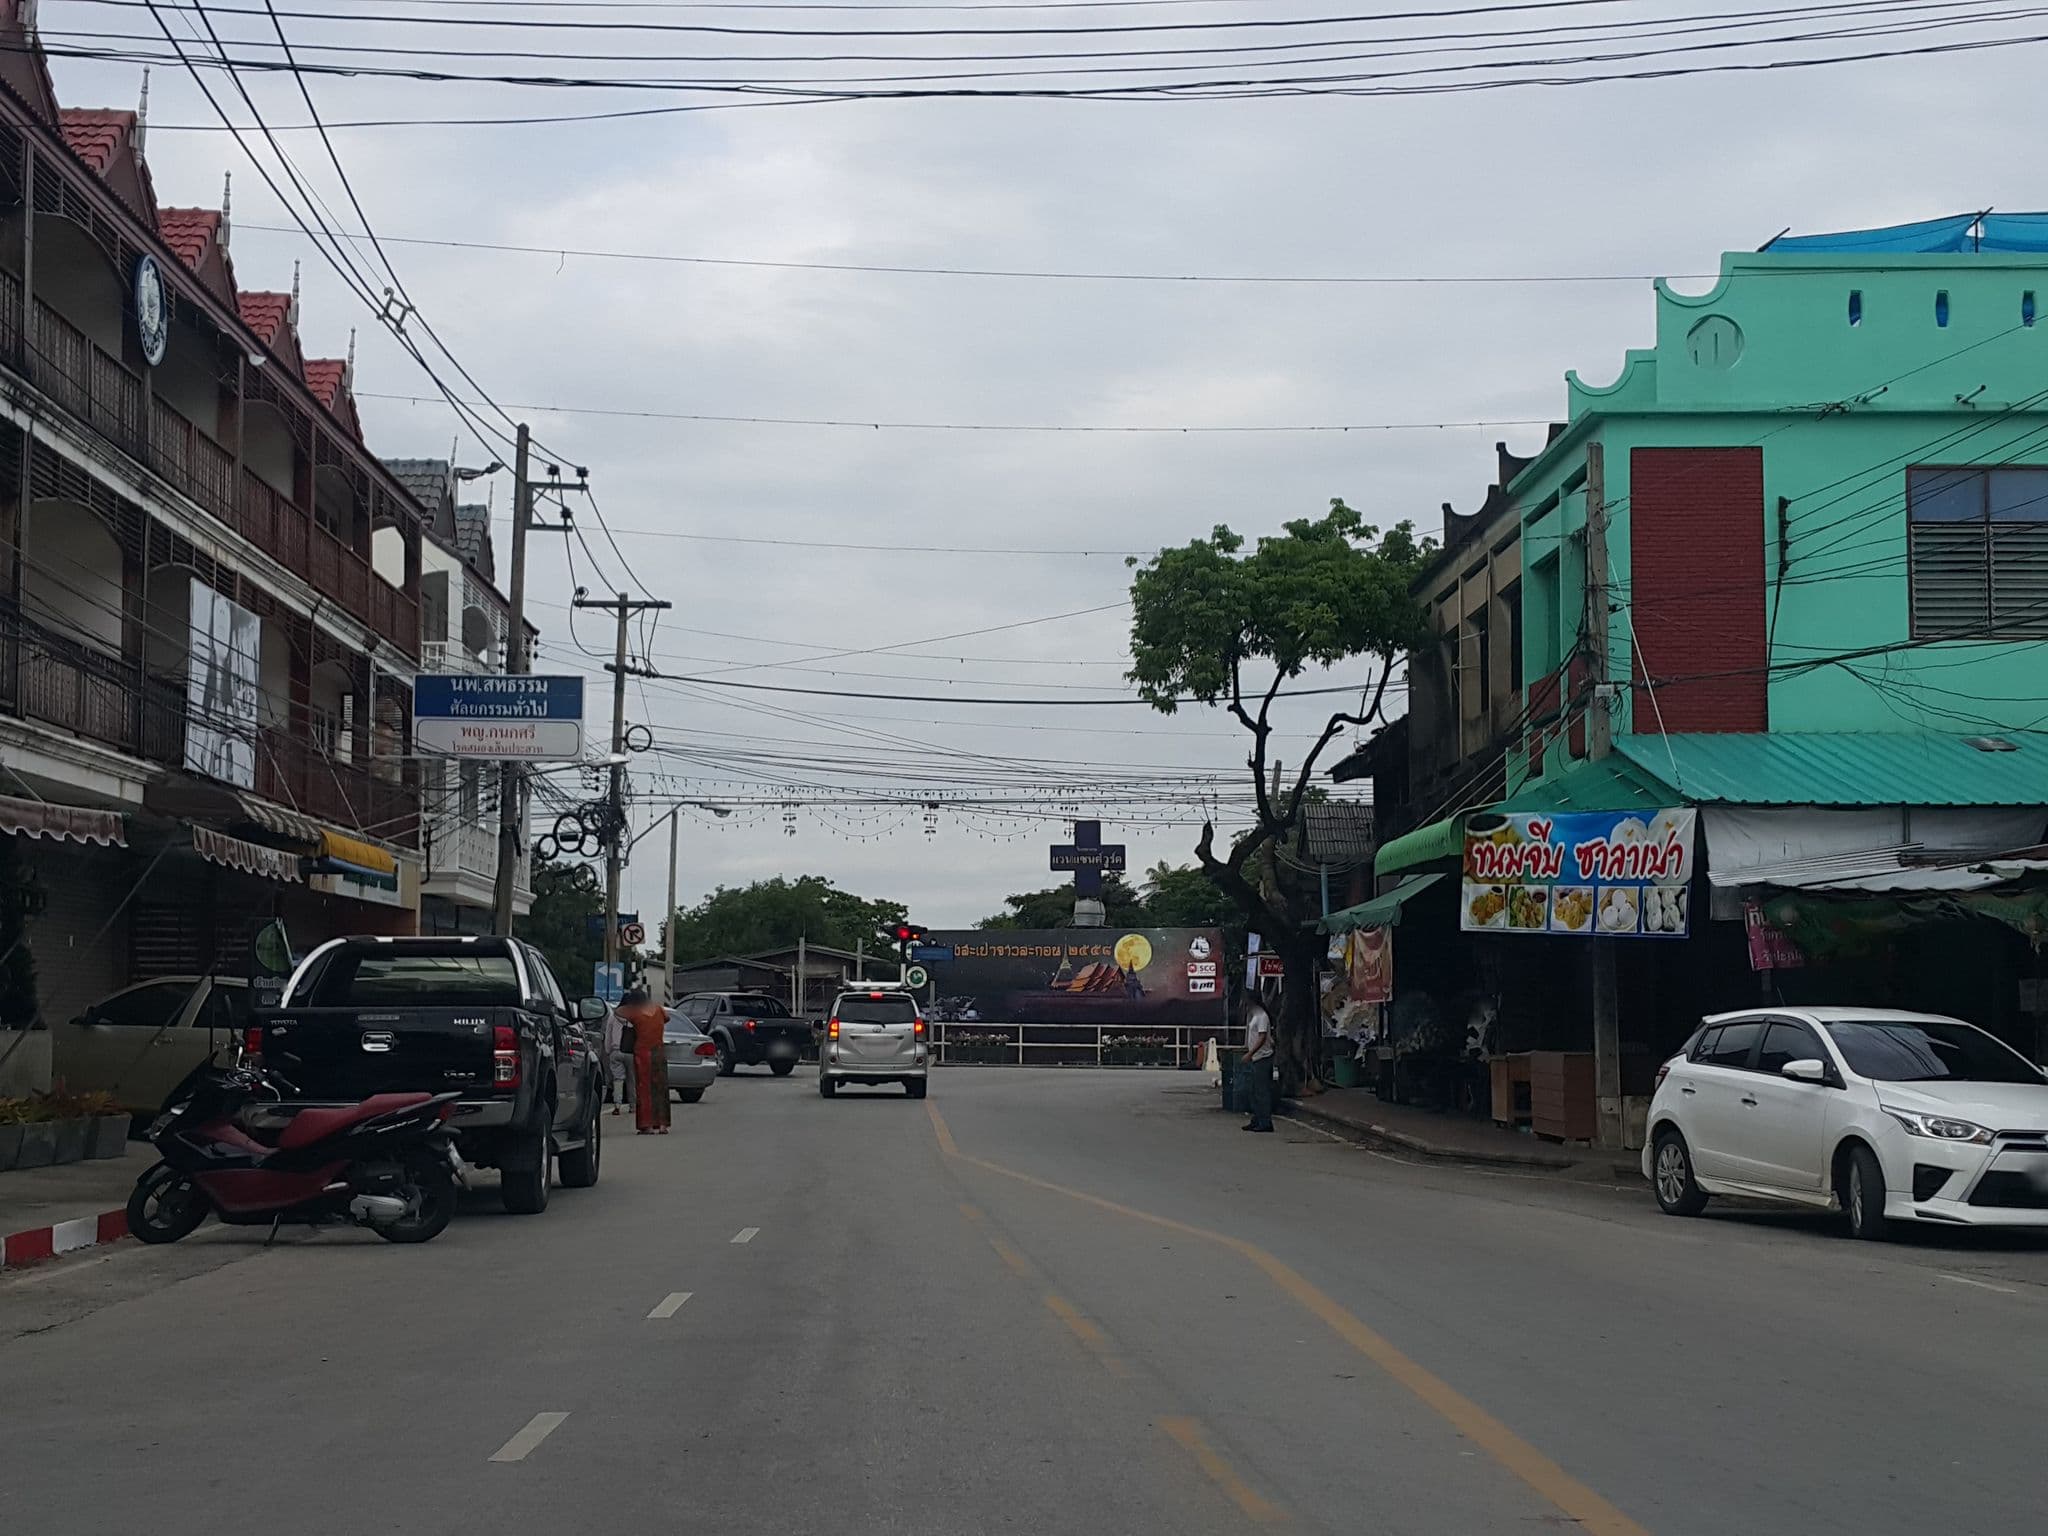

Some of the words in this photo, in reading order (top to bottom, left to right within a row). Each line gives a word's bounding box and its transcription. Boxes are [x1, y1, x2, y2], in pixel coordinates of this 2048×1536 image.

[450, 696, 547, 716] ศัลยกรรมทั่วไป
[461, 724, 535, 741] พญ.กนกศรี
[1475, 821, 1562, 876] ขนมจีบ
[1576, 830, 1683, 877] ซาลาเปา
[1200, 981, 1214, 990] ptt
